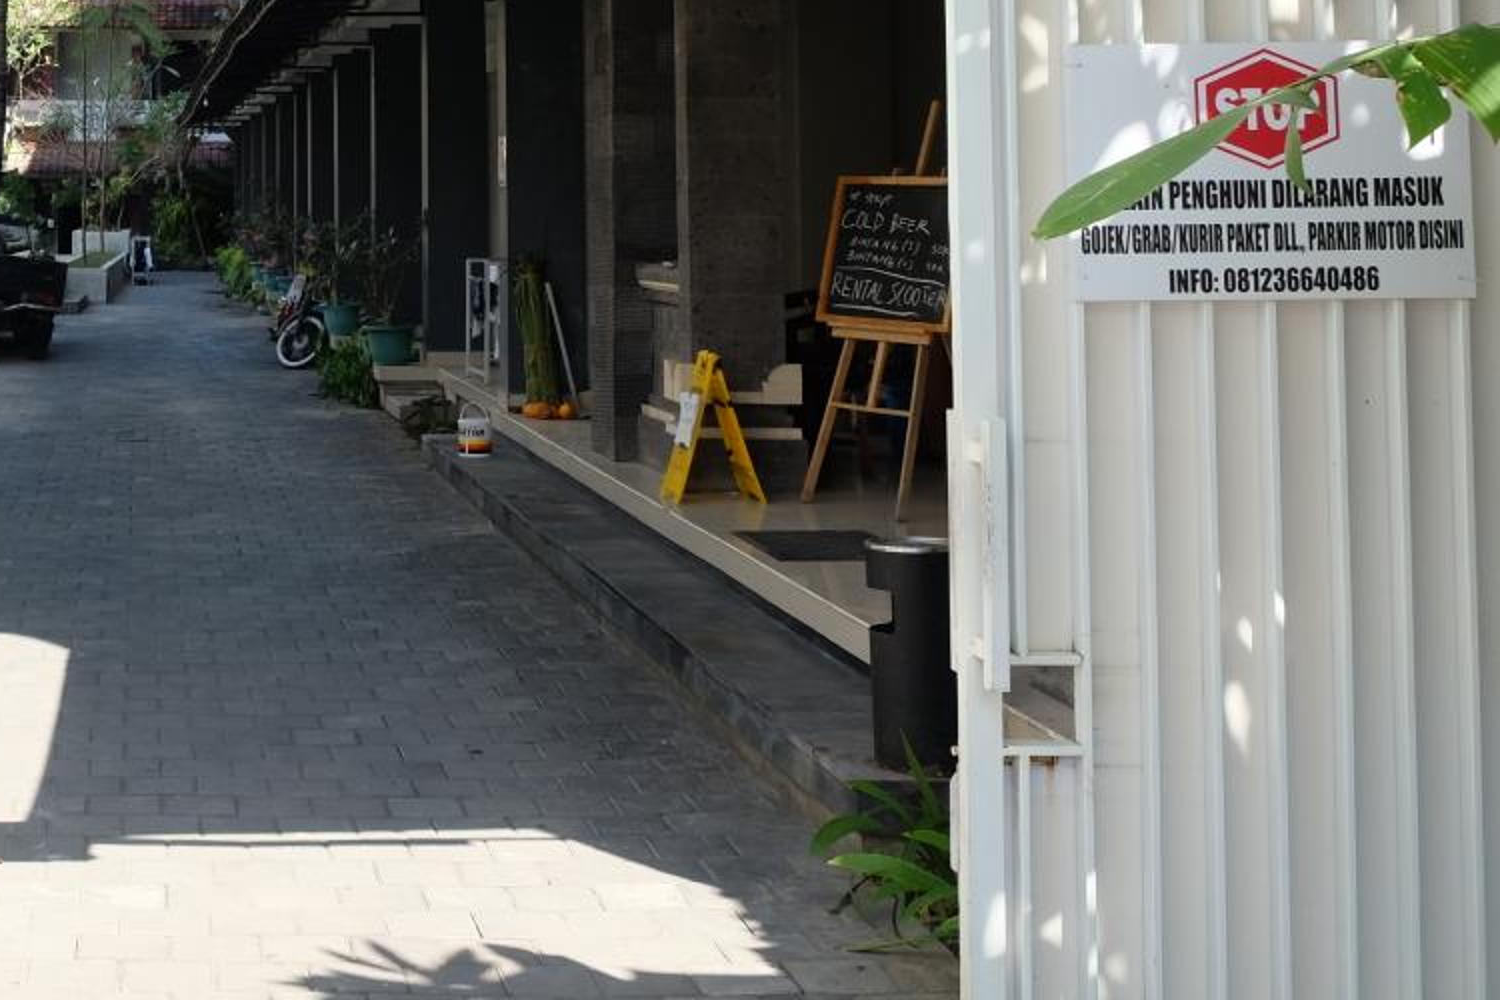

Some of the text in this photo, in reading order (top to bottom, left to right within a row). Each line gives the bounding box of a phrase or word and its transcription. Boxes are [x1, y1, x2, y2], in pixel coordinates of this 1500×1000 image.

[1169, 179, 1266, 210] PENGHUNI
[1272, 177, 1369, 209] DILARANG
[1373, 176, 1445, 207] MASUK
[842, 209, 932, 236] COLD BEER
[1081, 219, 1465, 254] GOJEK/GRAB/KURIR PAKET DLL, PARKIR MOTOR DISINI
[832, 271, 883, 305] RENTAL
[1169, 265, 1380, 293] INFO: 081236640486
